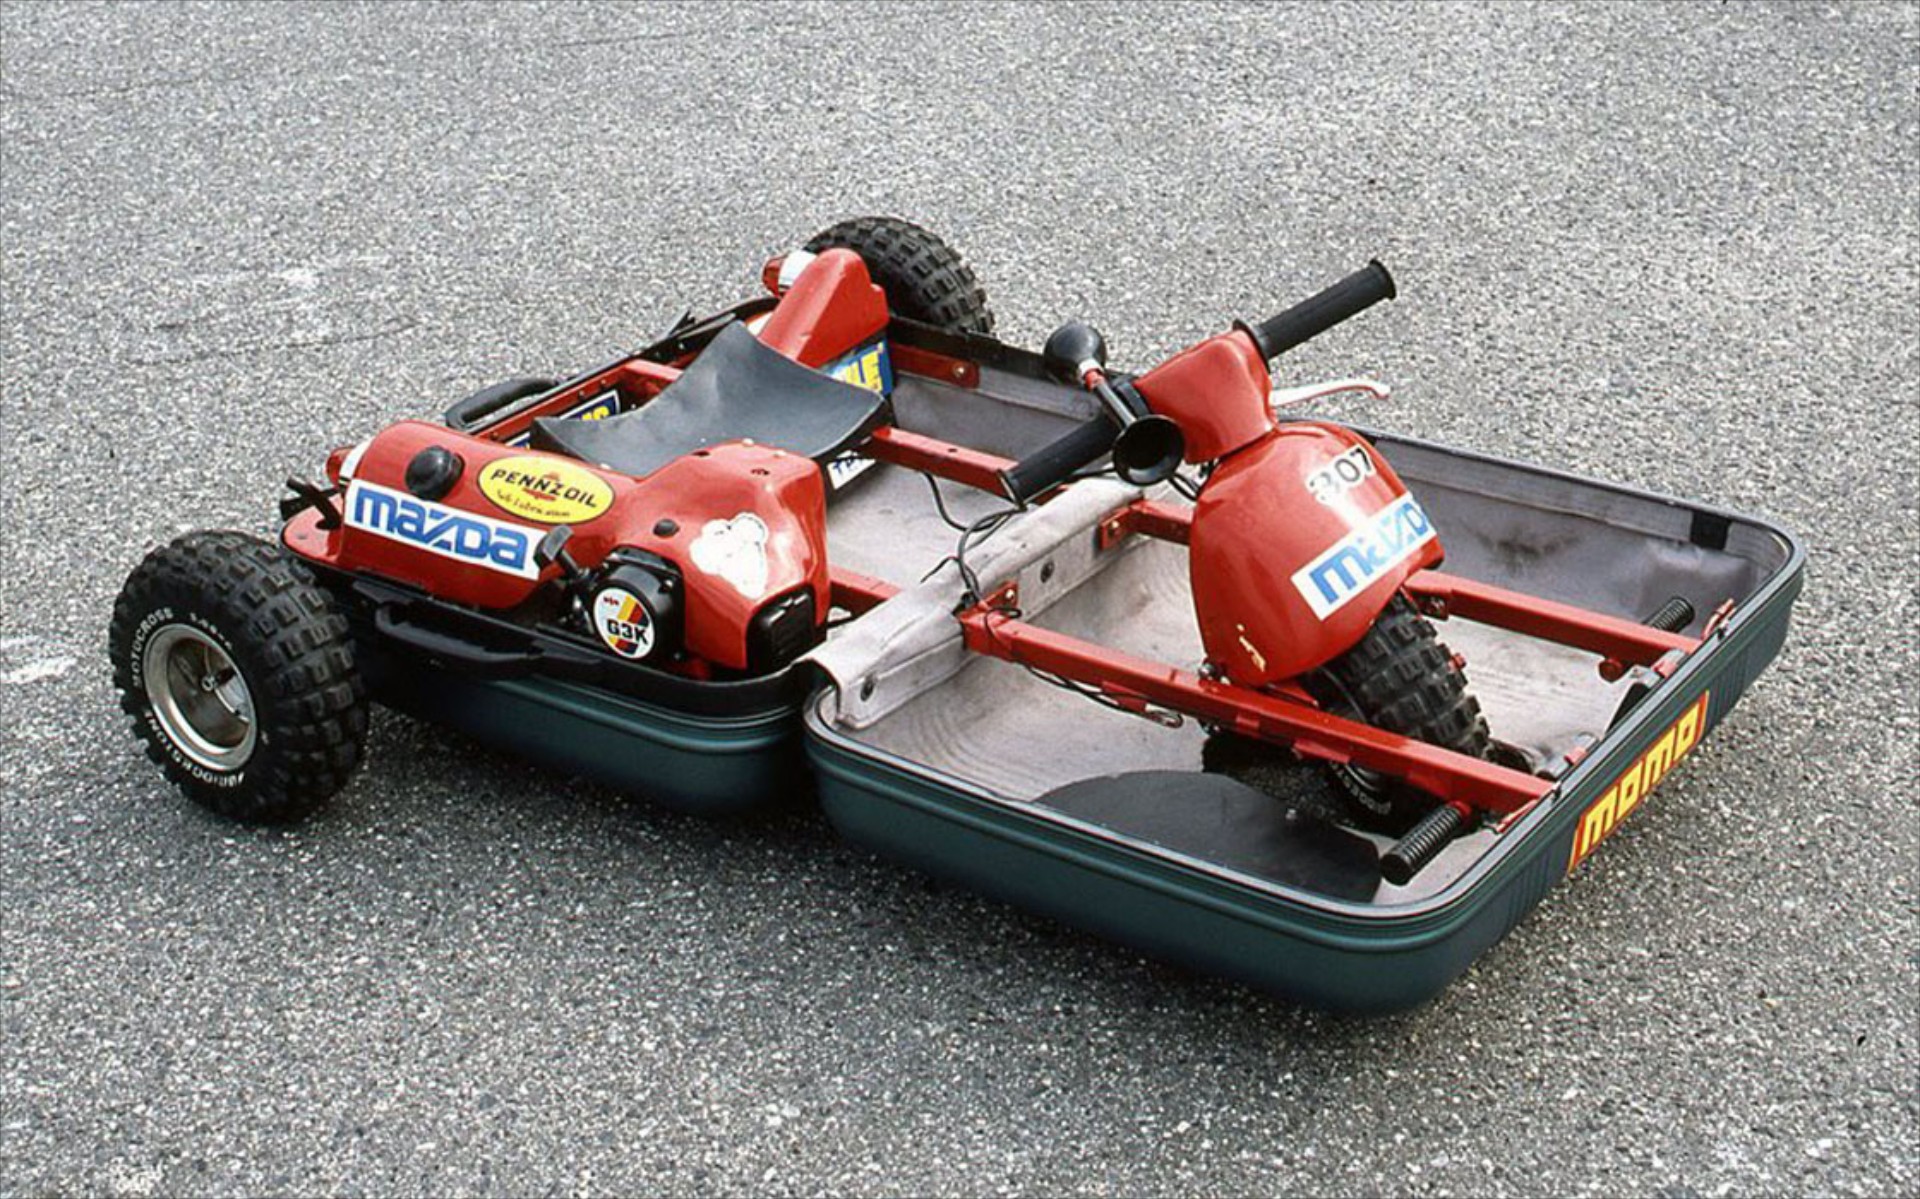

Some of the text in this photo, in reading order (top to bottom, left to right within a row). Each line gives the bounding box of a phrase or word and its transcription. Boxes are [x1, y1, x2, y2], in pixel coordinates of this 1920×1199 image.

[490, 468, 598, 508] PENNZOIL
[354, 486, 529, 570] mazda
[607, 618, 648, 645] G3K
